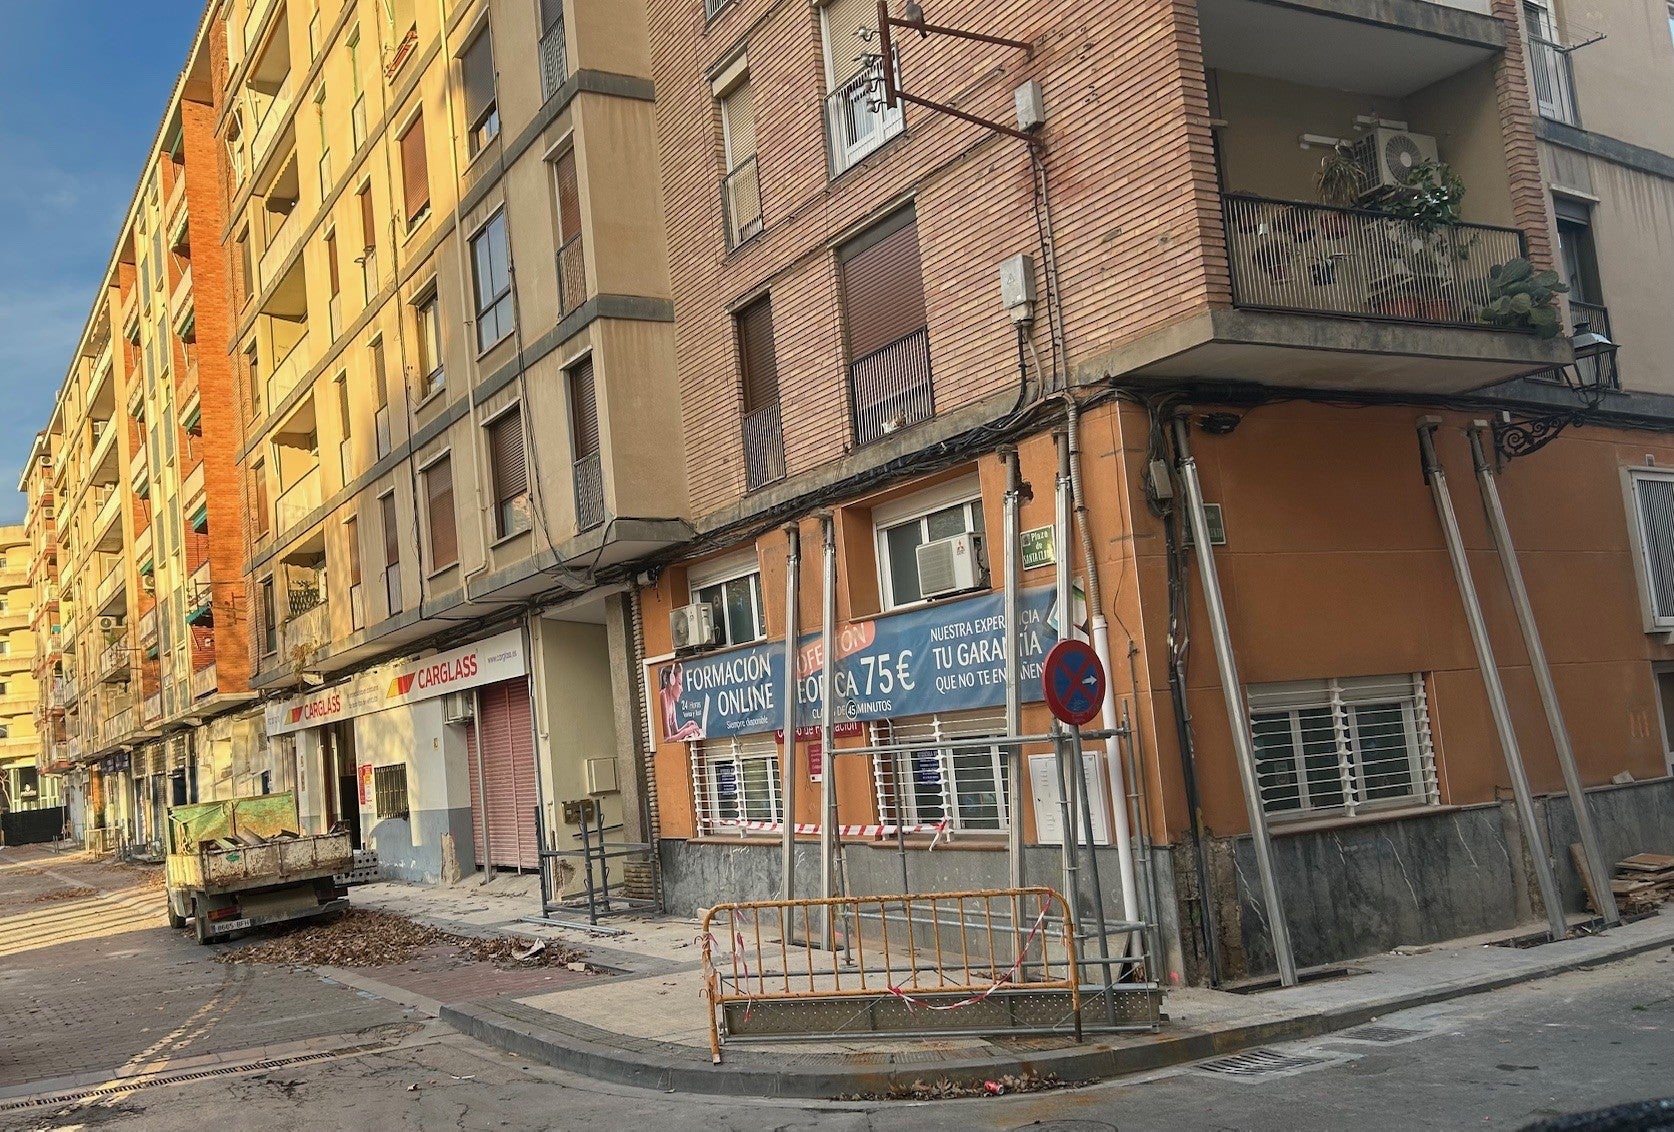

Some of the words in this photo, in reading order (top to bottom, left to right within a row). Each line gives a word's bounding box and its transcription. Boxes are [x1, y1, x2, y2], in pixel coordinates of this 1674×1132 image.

[930, 621, 973, 642] NUESTRA
[975, 608, 1040, 633] EXPERCIA
[797, 622, 867, 674] OFEÓN
[932, 645, 953, 669] TU
[418, 653, 478, 690] CARGLASS
[686, 648, 771, 692] FORMACIÓN
[936, 674, 957, 695] QUE
[958, 672, 975, 689] NO
[976, 669, 990, 686] TE
[993, 661, 1044, 683] ENÑEN
[304, 694, 341, 720] CARGLASS
[718, 683, 774, 717] ONLINE
[848, 704, 856, 716] 45
[856, 699, 892, 713] MINUTOS
